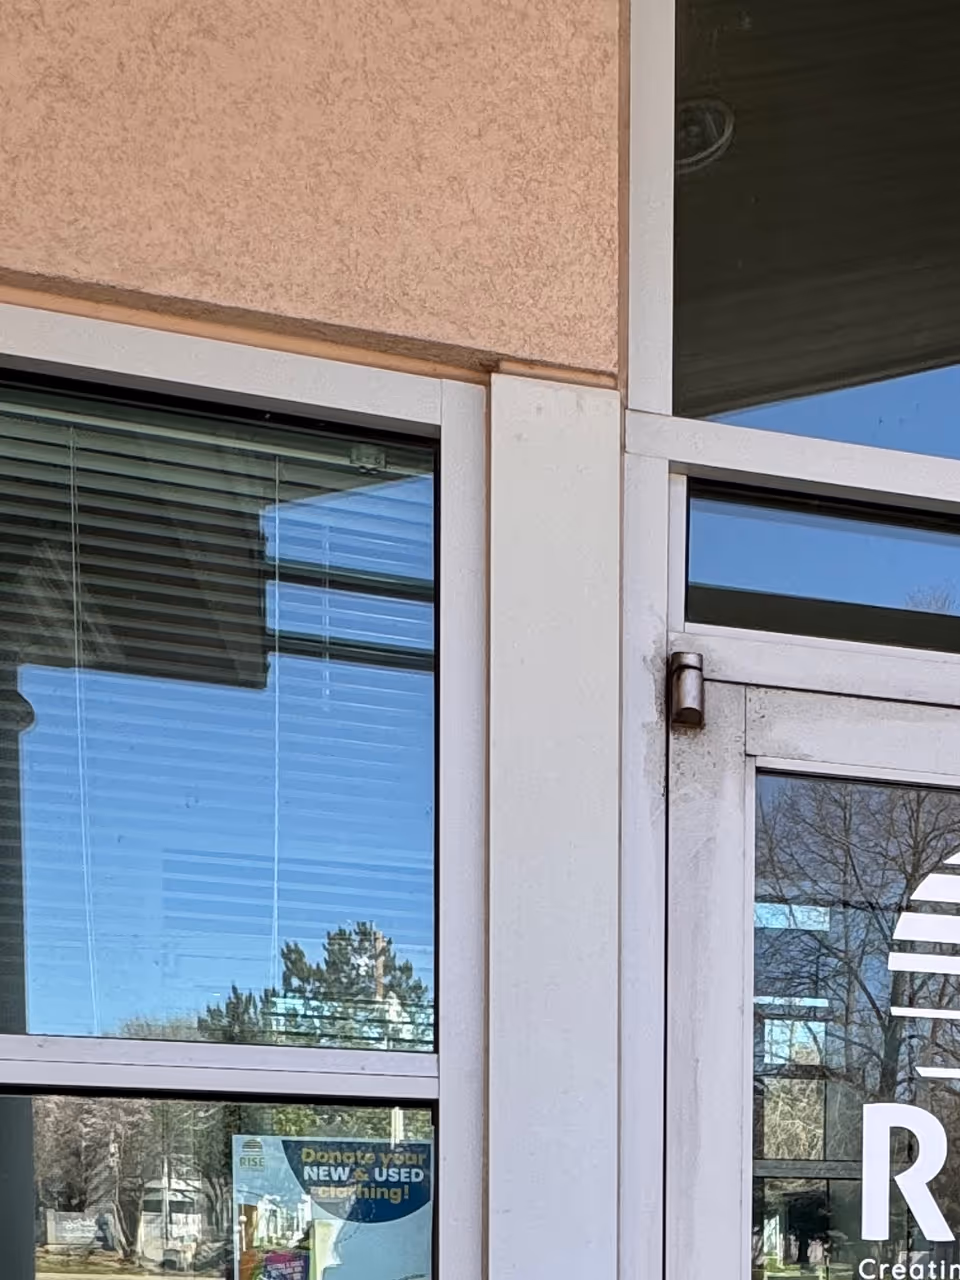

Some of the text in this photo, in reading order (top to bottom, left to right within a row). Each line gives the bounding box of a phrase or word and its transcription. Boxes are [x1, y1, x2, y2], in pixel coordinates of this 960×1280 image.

[239, 1156, 265, 1168] RISE
[301, 1148, 427, 1170] Donate your
[303, 1166, 425, 1182] NEW & USED
[317, 1184, 410, 1205] clothing!
